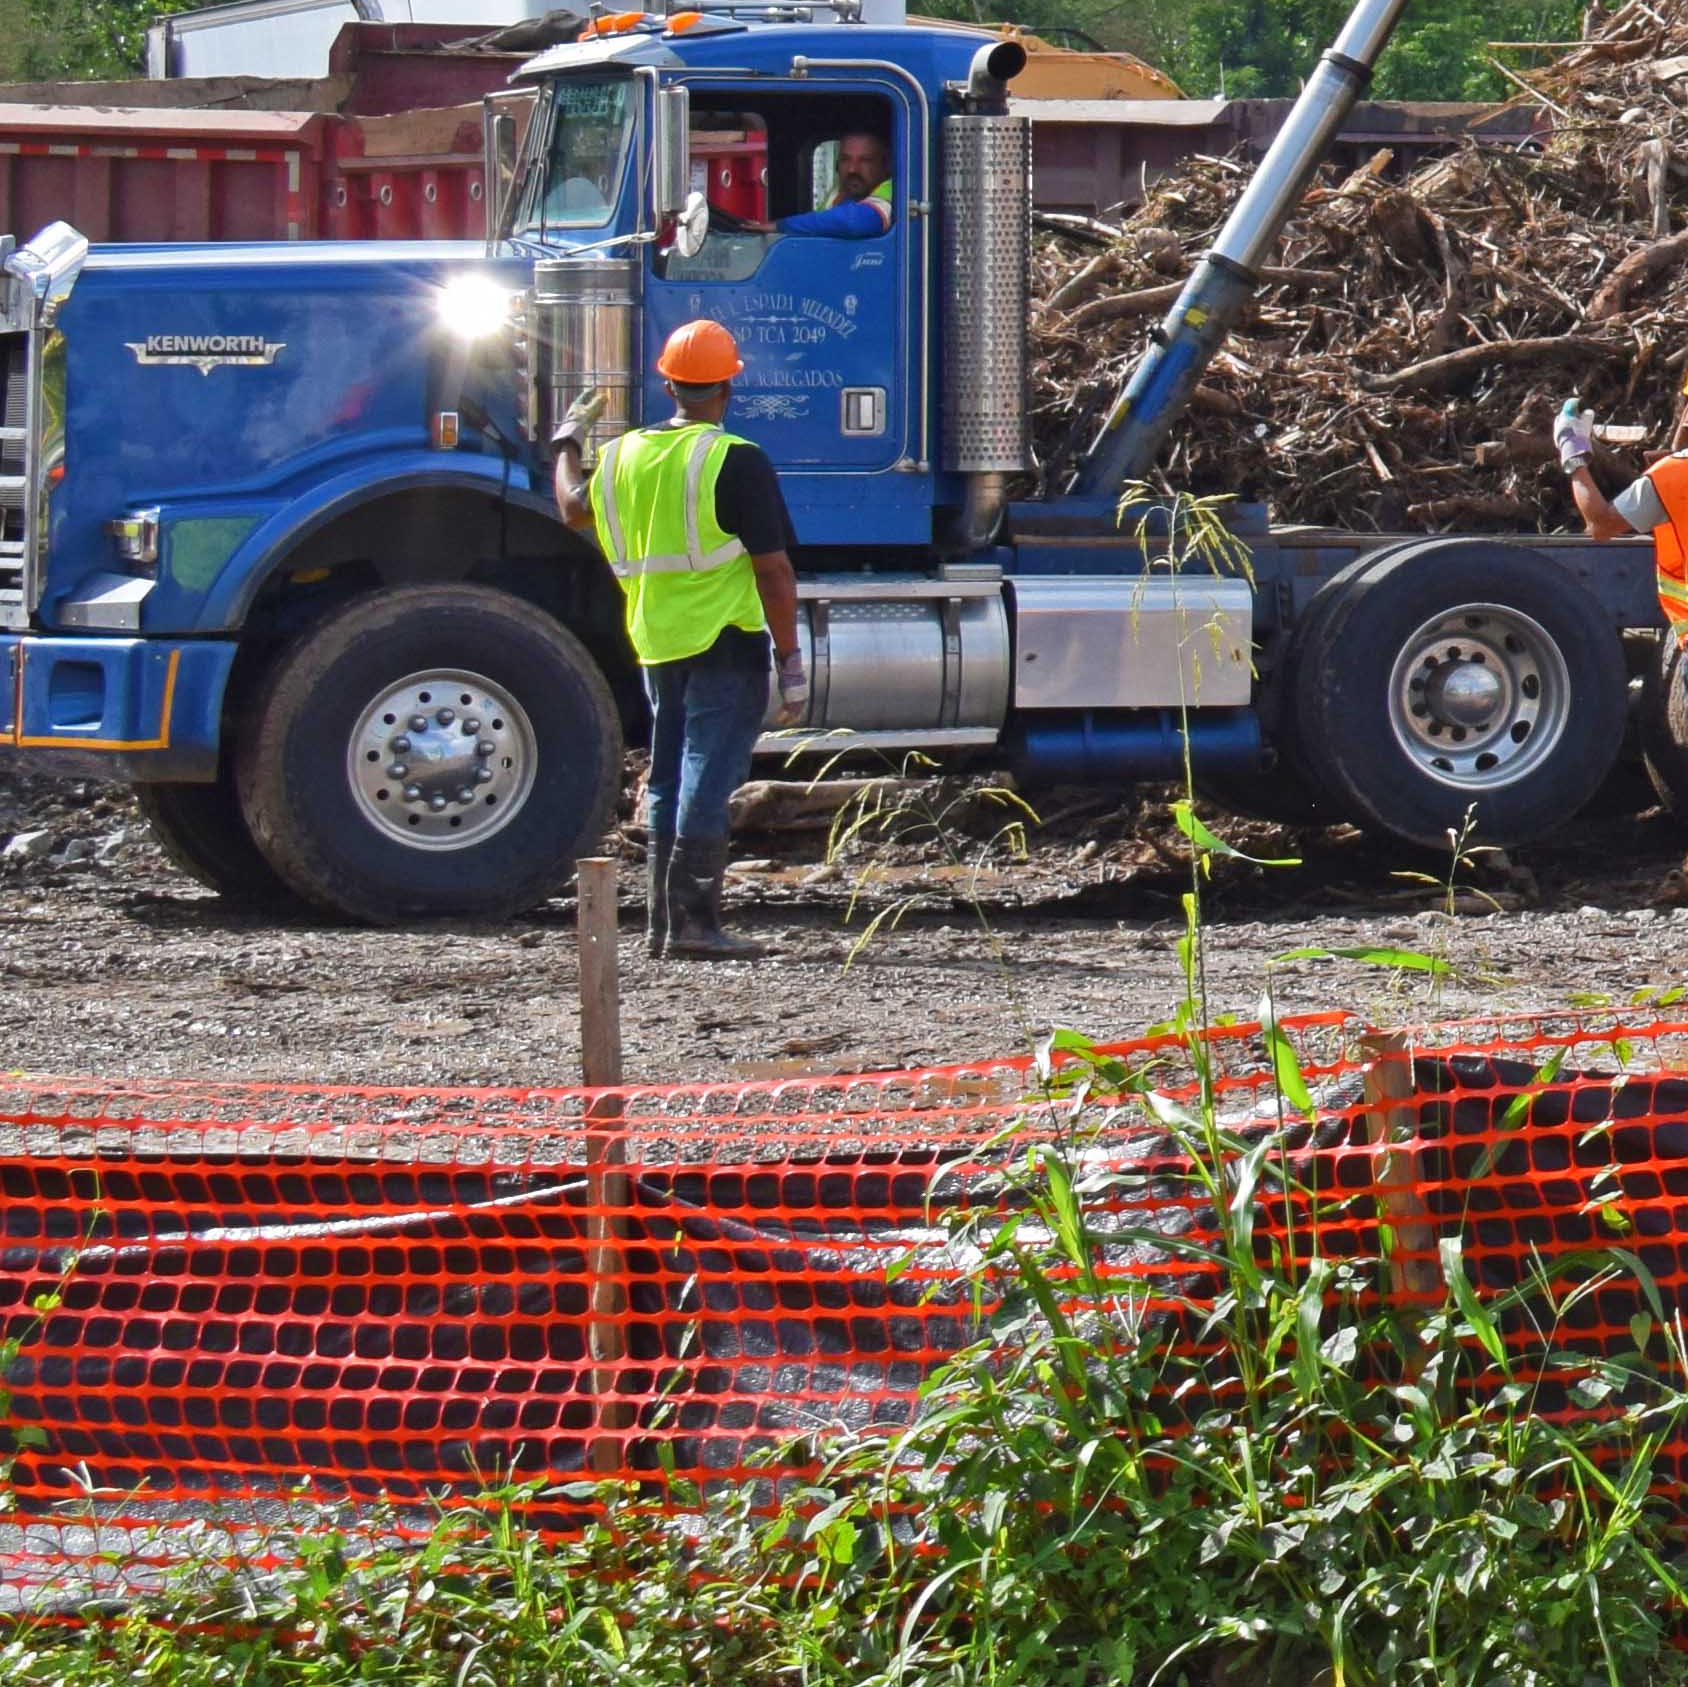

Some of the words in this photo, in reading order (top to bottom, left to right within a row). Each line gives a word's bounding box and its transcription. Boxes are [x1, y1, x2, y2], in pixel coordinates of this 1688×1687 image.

[147, 335, 264, 352] KENWORTH
[758, 326, 786, 343] TCA
[793, 327, 826, 344] 2049
